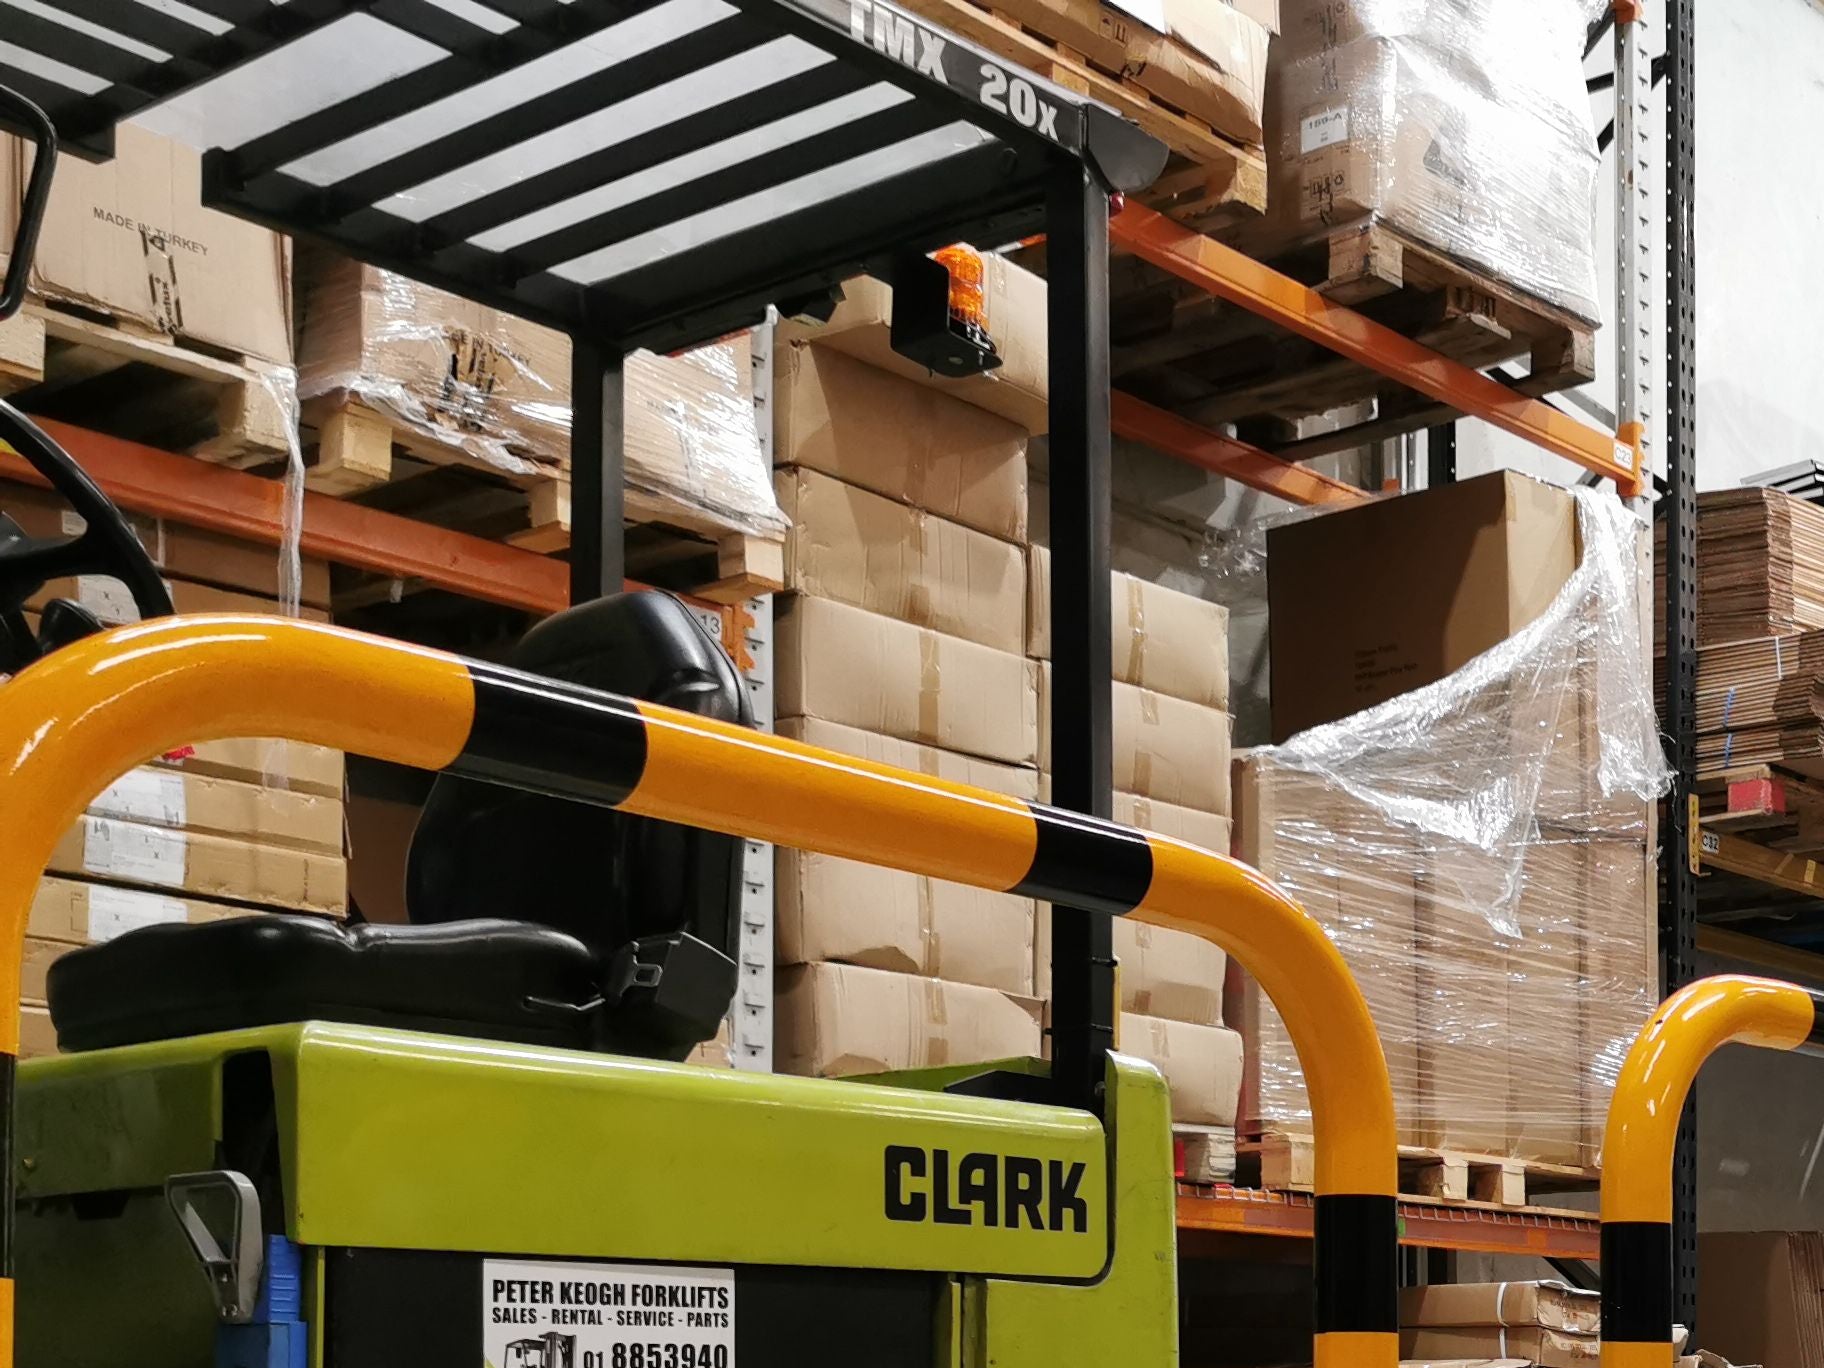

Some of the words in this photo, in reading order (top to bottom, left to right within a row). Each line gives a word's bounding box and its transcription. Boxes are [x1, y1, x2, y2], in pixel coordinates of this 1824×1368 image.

[848, 0, 948, 86] TMX
[93, 206, 135, 232] MADE
[138, 222, 151, 236] IN
[155, 228, 208, 256] TURKEY
[884, 1145, 1088, 1234] CLARK
[493, 1279, 554, 1305] PETER
[560, 1281, 626, 1306] KEOGH
[632, 1284, 729, 1310] FORKLIFTS
[493, 1307, 537, 1324] SALES
[552, 1309, 604, 1326] RENTAL
[617, 1310, 674, 1328] SERVICE
[687, 1312, 729, 1329] PARTS
